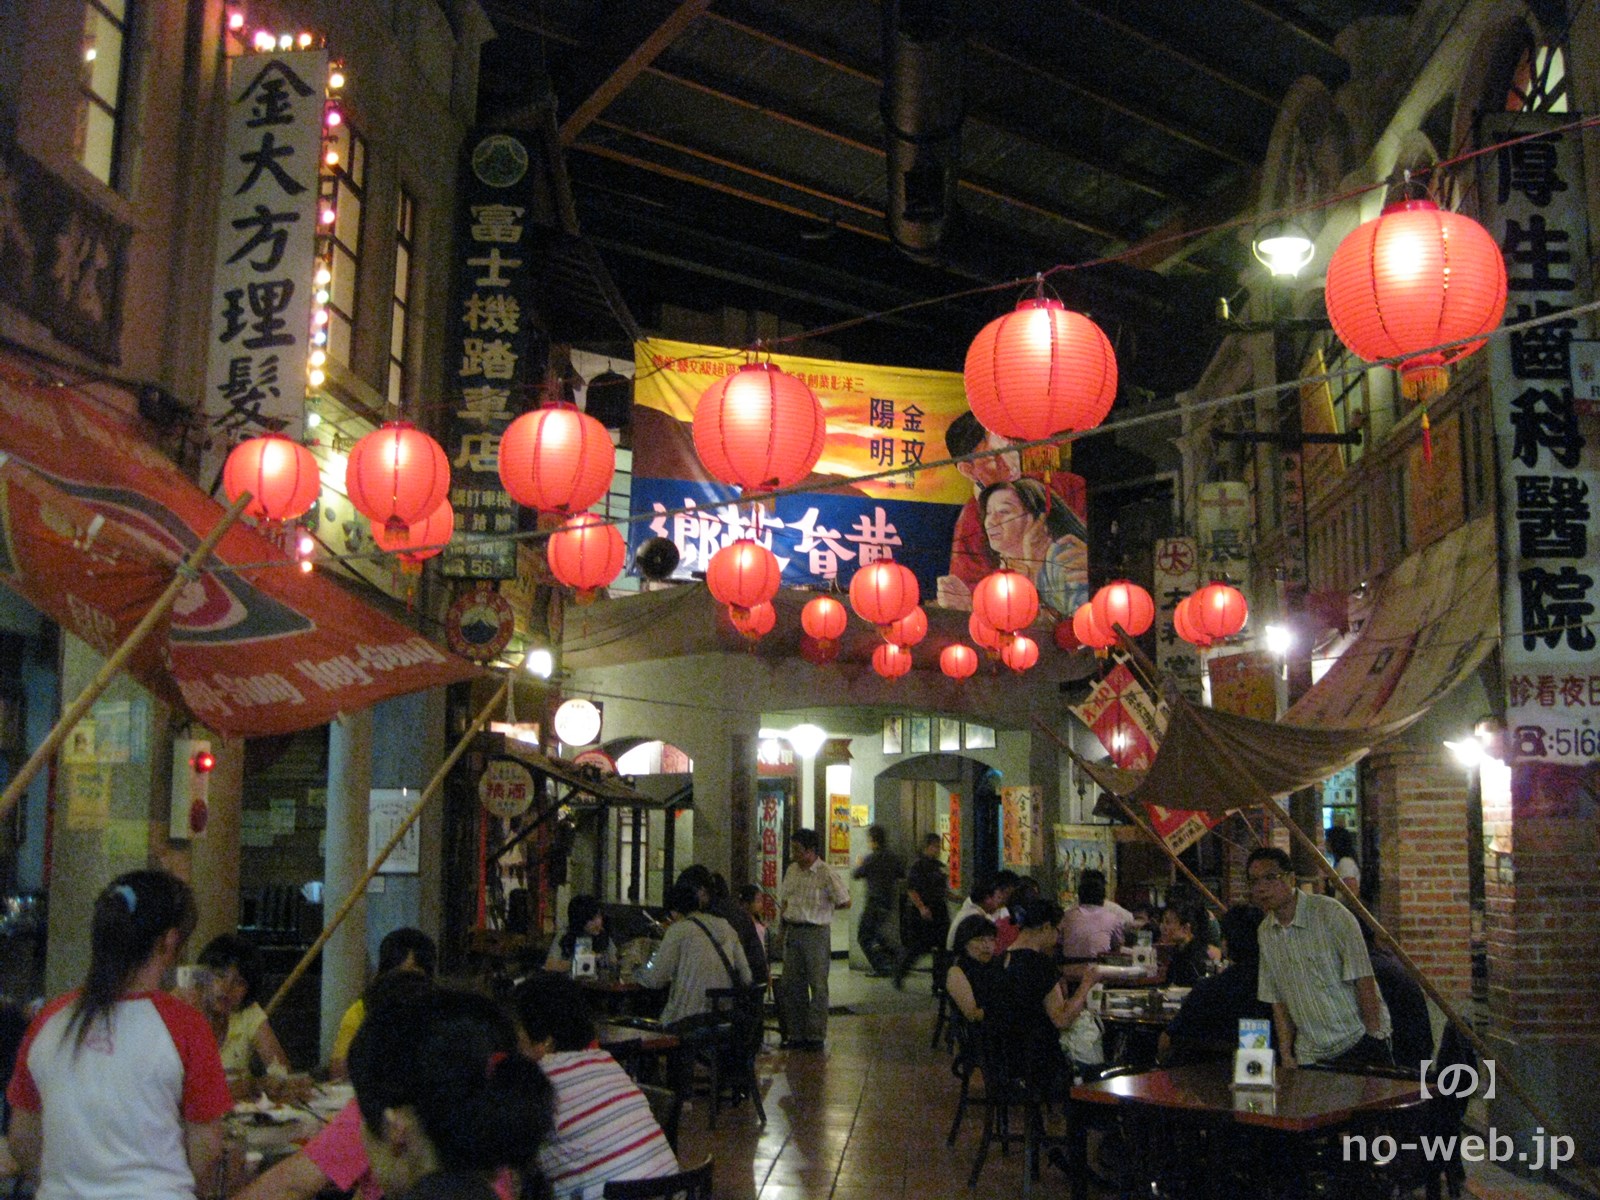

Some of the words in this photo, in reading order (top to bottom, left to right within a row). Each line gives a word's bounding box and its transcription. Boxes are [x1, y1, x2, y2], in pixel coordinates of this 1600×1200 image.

[211, 58, 315, 440] 金大方理髮
[869, 397, 895, 467] 陽明
